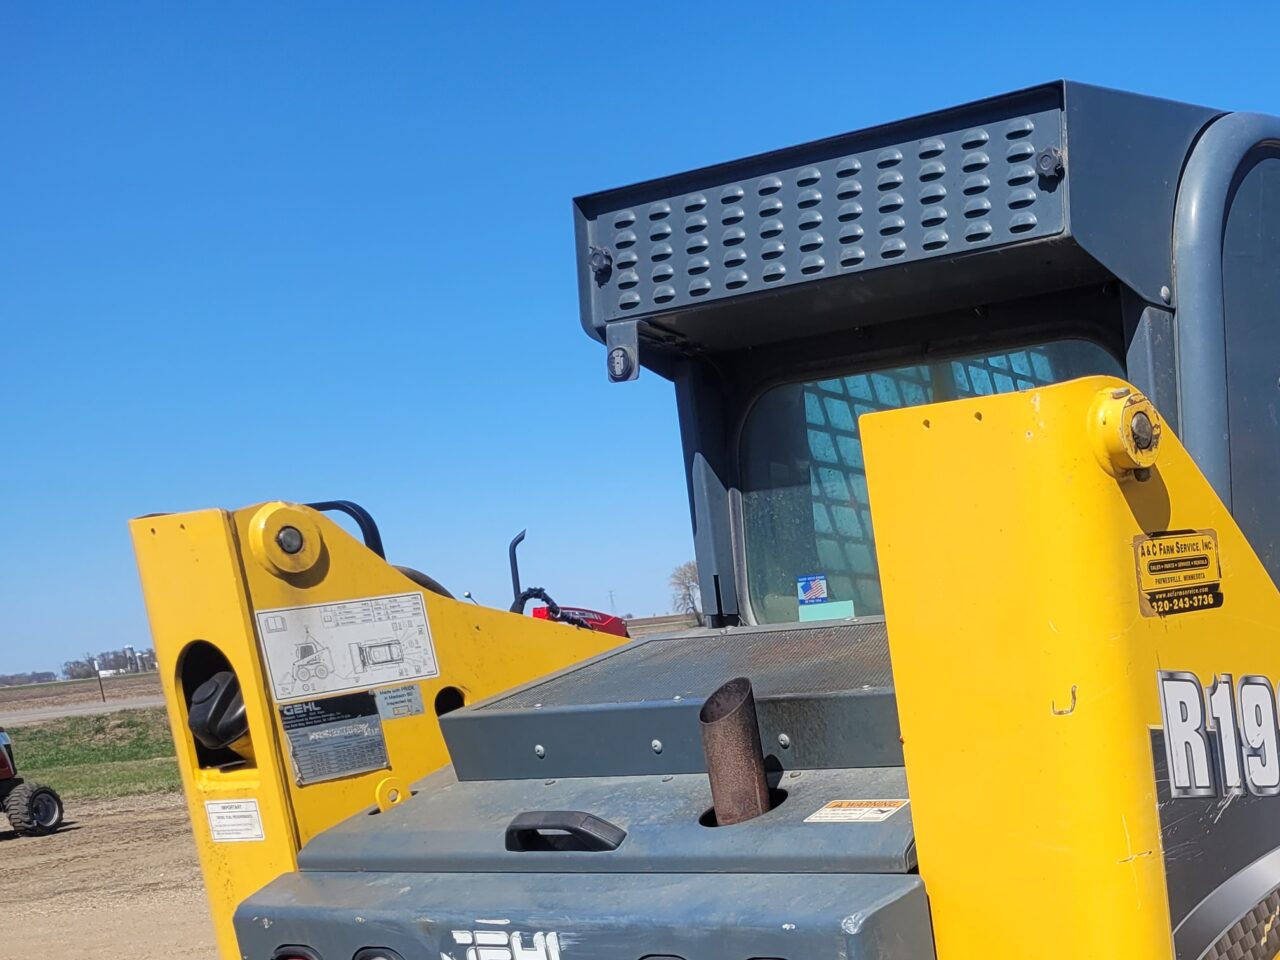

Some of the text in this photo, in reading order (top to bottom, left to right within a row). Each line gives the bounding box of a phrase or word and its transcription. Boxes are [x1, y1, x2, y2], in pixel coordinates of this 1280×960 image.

[1159, 543, 1175, 556] FARM
[1183, 573, 1206, 581] MINNESOTA
[283, 702, 321, 715] GEHL
